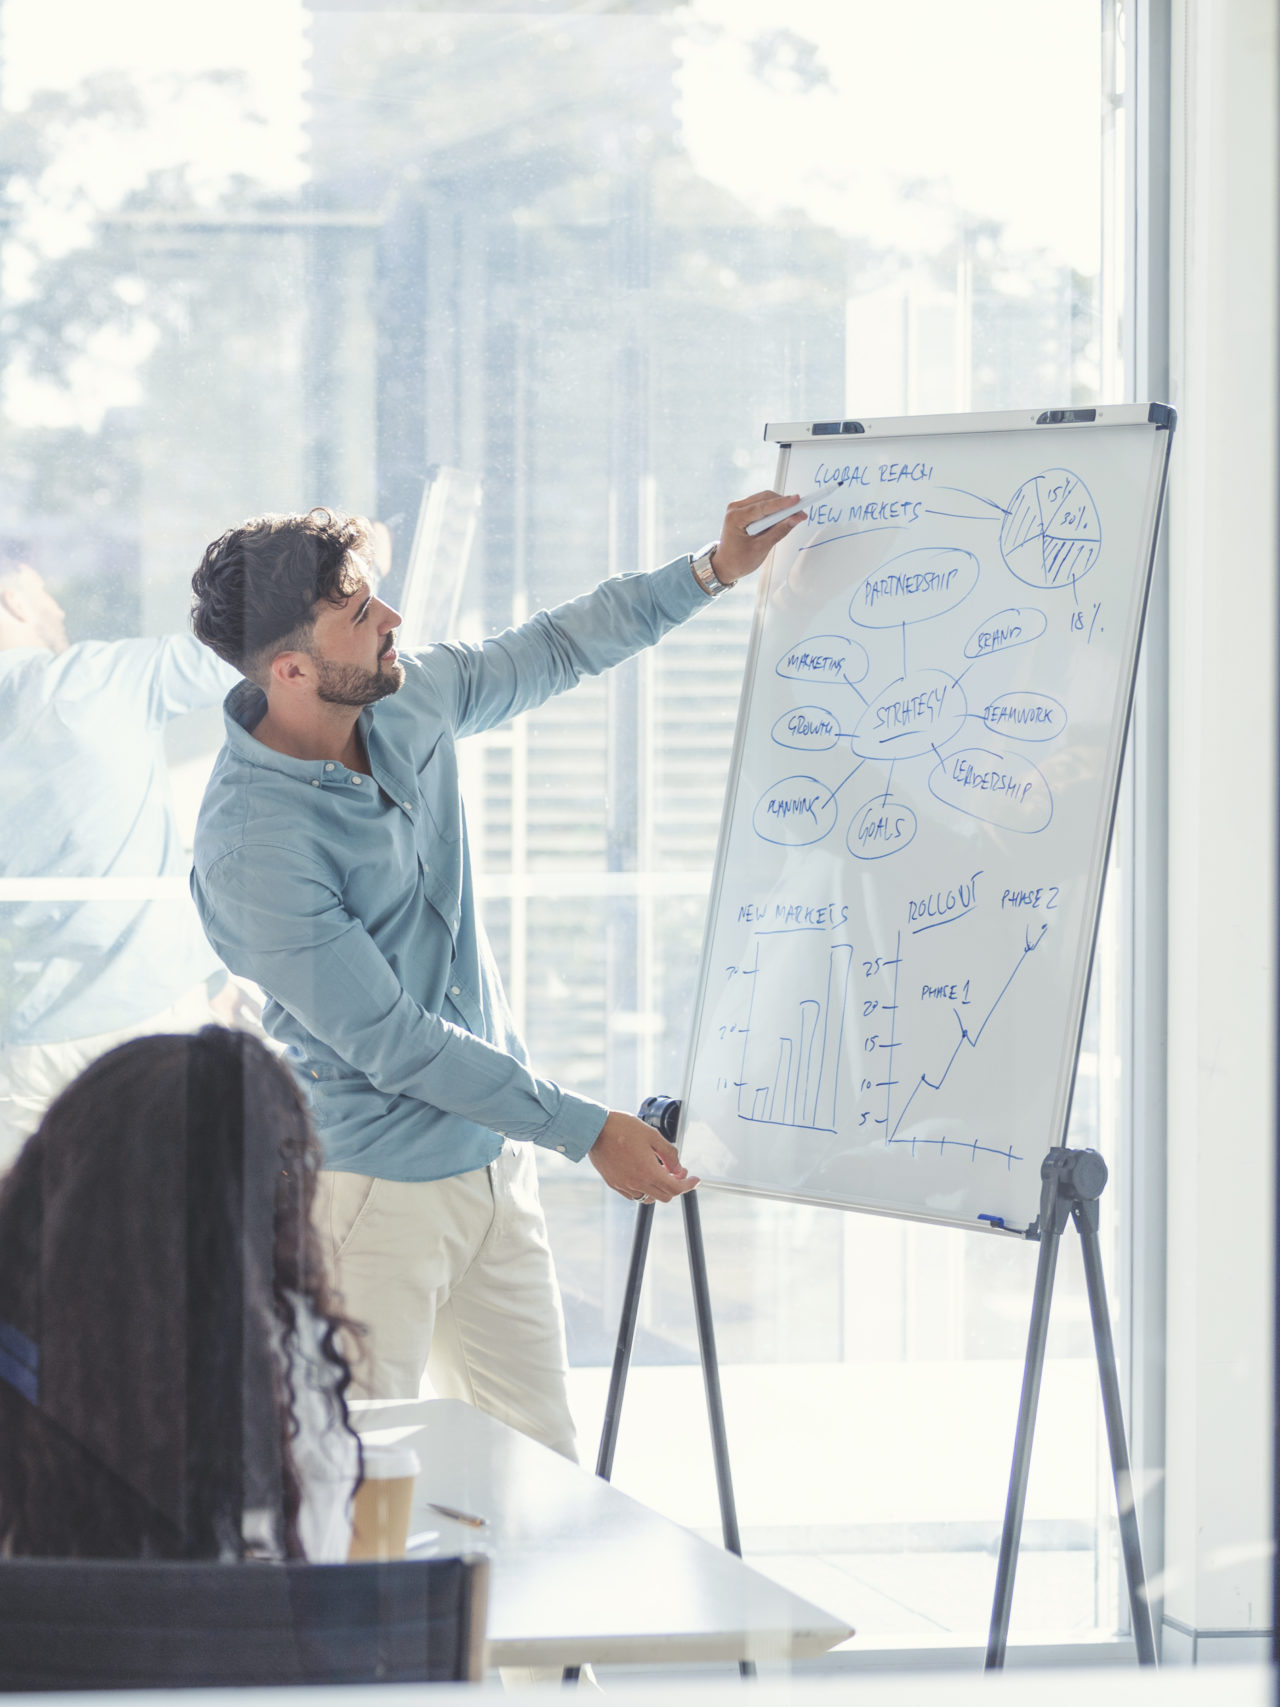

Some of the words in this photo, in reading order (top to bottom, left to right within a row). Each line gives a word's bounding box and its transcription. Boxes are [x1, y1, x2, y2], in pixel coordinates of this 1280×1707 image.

[815, 463, 870, 488] GLOBAL
[879, 463, 933, 482] REACH
[808, 504, 842, 526] NEW
[848, 502, 922, 523] MARKETS
[865, 569, 958, 606] PARTNERSHIP
[978, 626, 1022, 652] BRAND
[787, 652, 846, 677] MARKETING
[872, 684, 947, 730] STRATEGY
[984, 706, 1054, 724] TEAMWORK
[788, 715, 833, 736] GROWTH
[953, 758, 1032, 803] LEADERSHIP
[858, 809, 905, 847] GOALS
[908, 871, 984, 924] ROLLOUT
[1002, 888, 1044, 909] PHASE
[1047, 887, 1060, 909] 2
[738, 905, 767, 923] NEW
[775, 904, 849, 930] MARKETS
[863, 957, 883, 977] 25
[922, 984, 958, 1000] PHASE
[962, 979, 972, 1005] 1
[863, 1000, 879, 1016] 20
[864, 1035, 879, 1052] 15
[861, 1079, 872, 1092] 10
[859, 1111, 870, 1126] 5
